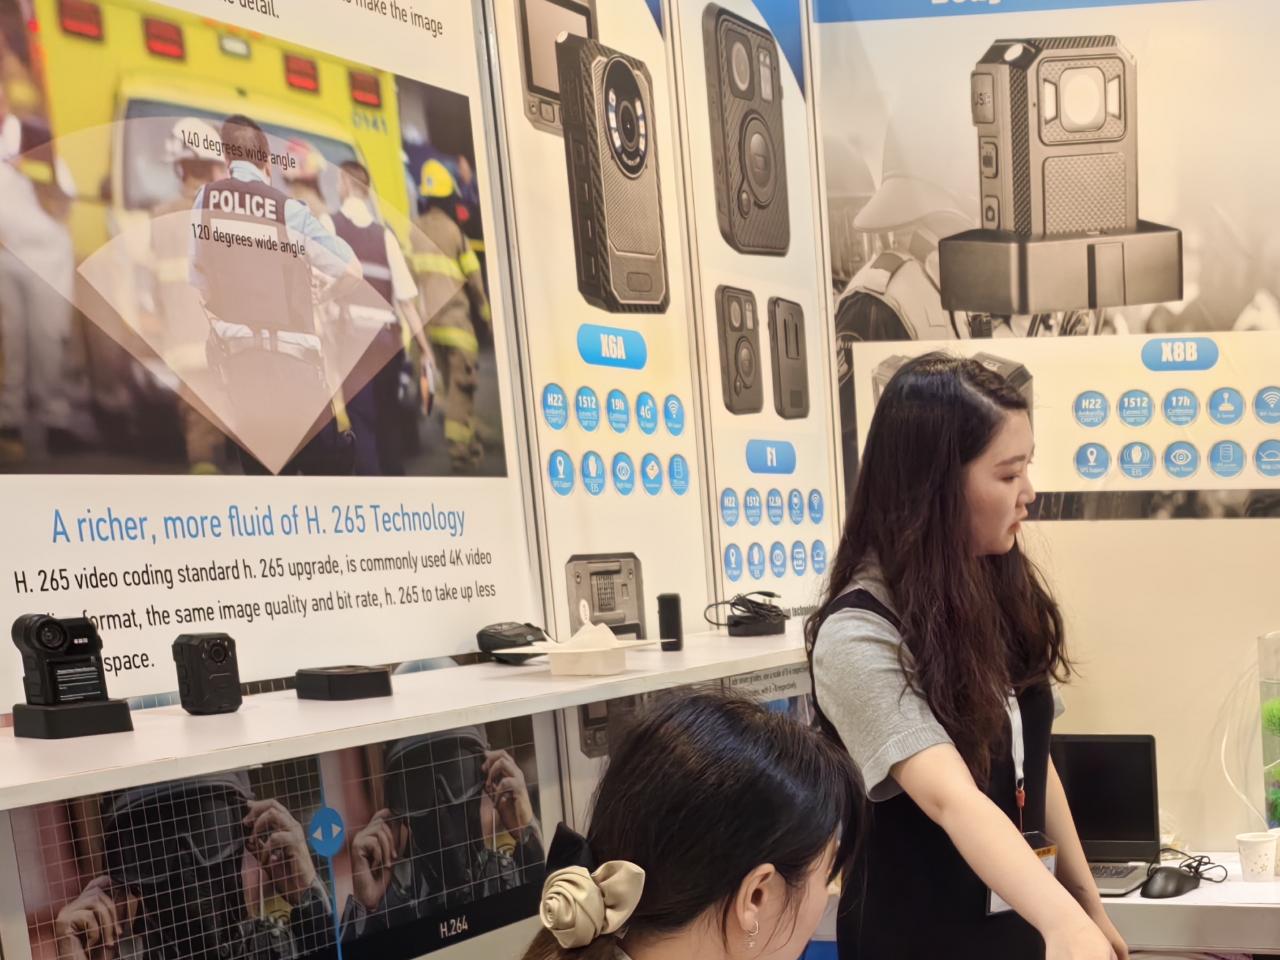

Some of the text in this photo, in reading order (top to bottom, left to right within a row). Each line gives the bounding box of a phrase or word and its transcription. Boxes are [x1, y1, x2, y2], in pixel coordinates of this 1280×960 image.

[390, 3, 408, 22] the
[410, 6, 444, 38] image
[181, 129, 296, 171] 140 degrees wide angle
[209, 190, 277, 220] POLICE
[191, 223, 306, 258] 120 degrees wide angle
[1160, 341, 1198, 362] X8B
[52, 502, 465, 545] A richer, more fluid of H. 265 Technology
[14, 547, 492, 594] H. 265 video coding standard h. 265 upgrade, is commonly used 4K video
[146, 603, 170, 627] the
[174, 604, 215, 625] same
[217, 599, 261, 624] image
[264, 593, 308, 621] quality
[311, 591, 334, 613] and
[336, 590, 353, 610] bit
[355, 590, 383, 609] rate,
[384, 586, 397, 606] h.
[398, 585, 419, 605] 265
[420, 586, 433, 603] to
[434, 581, 458, 602] take
[460, 585, 473, 603] up
[474, 579, 496, 598] less
[103, 651, 155, 677] space.
[439, 915, 469, 939] H.264
